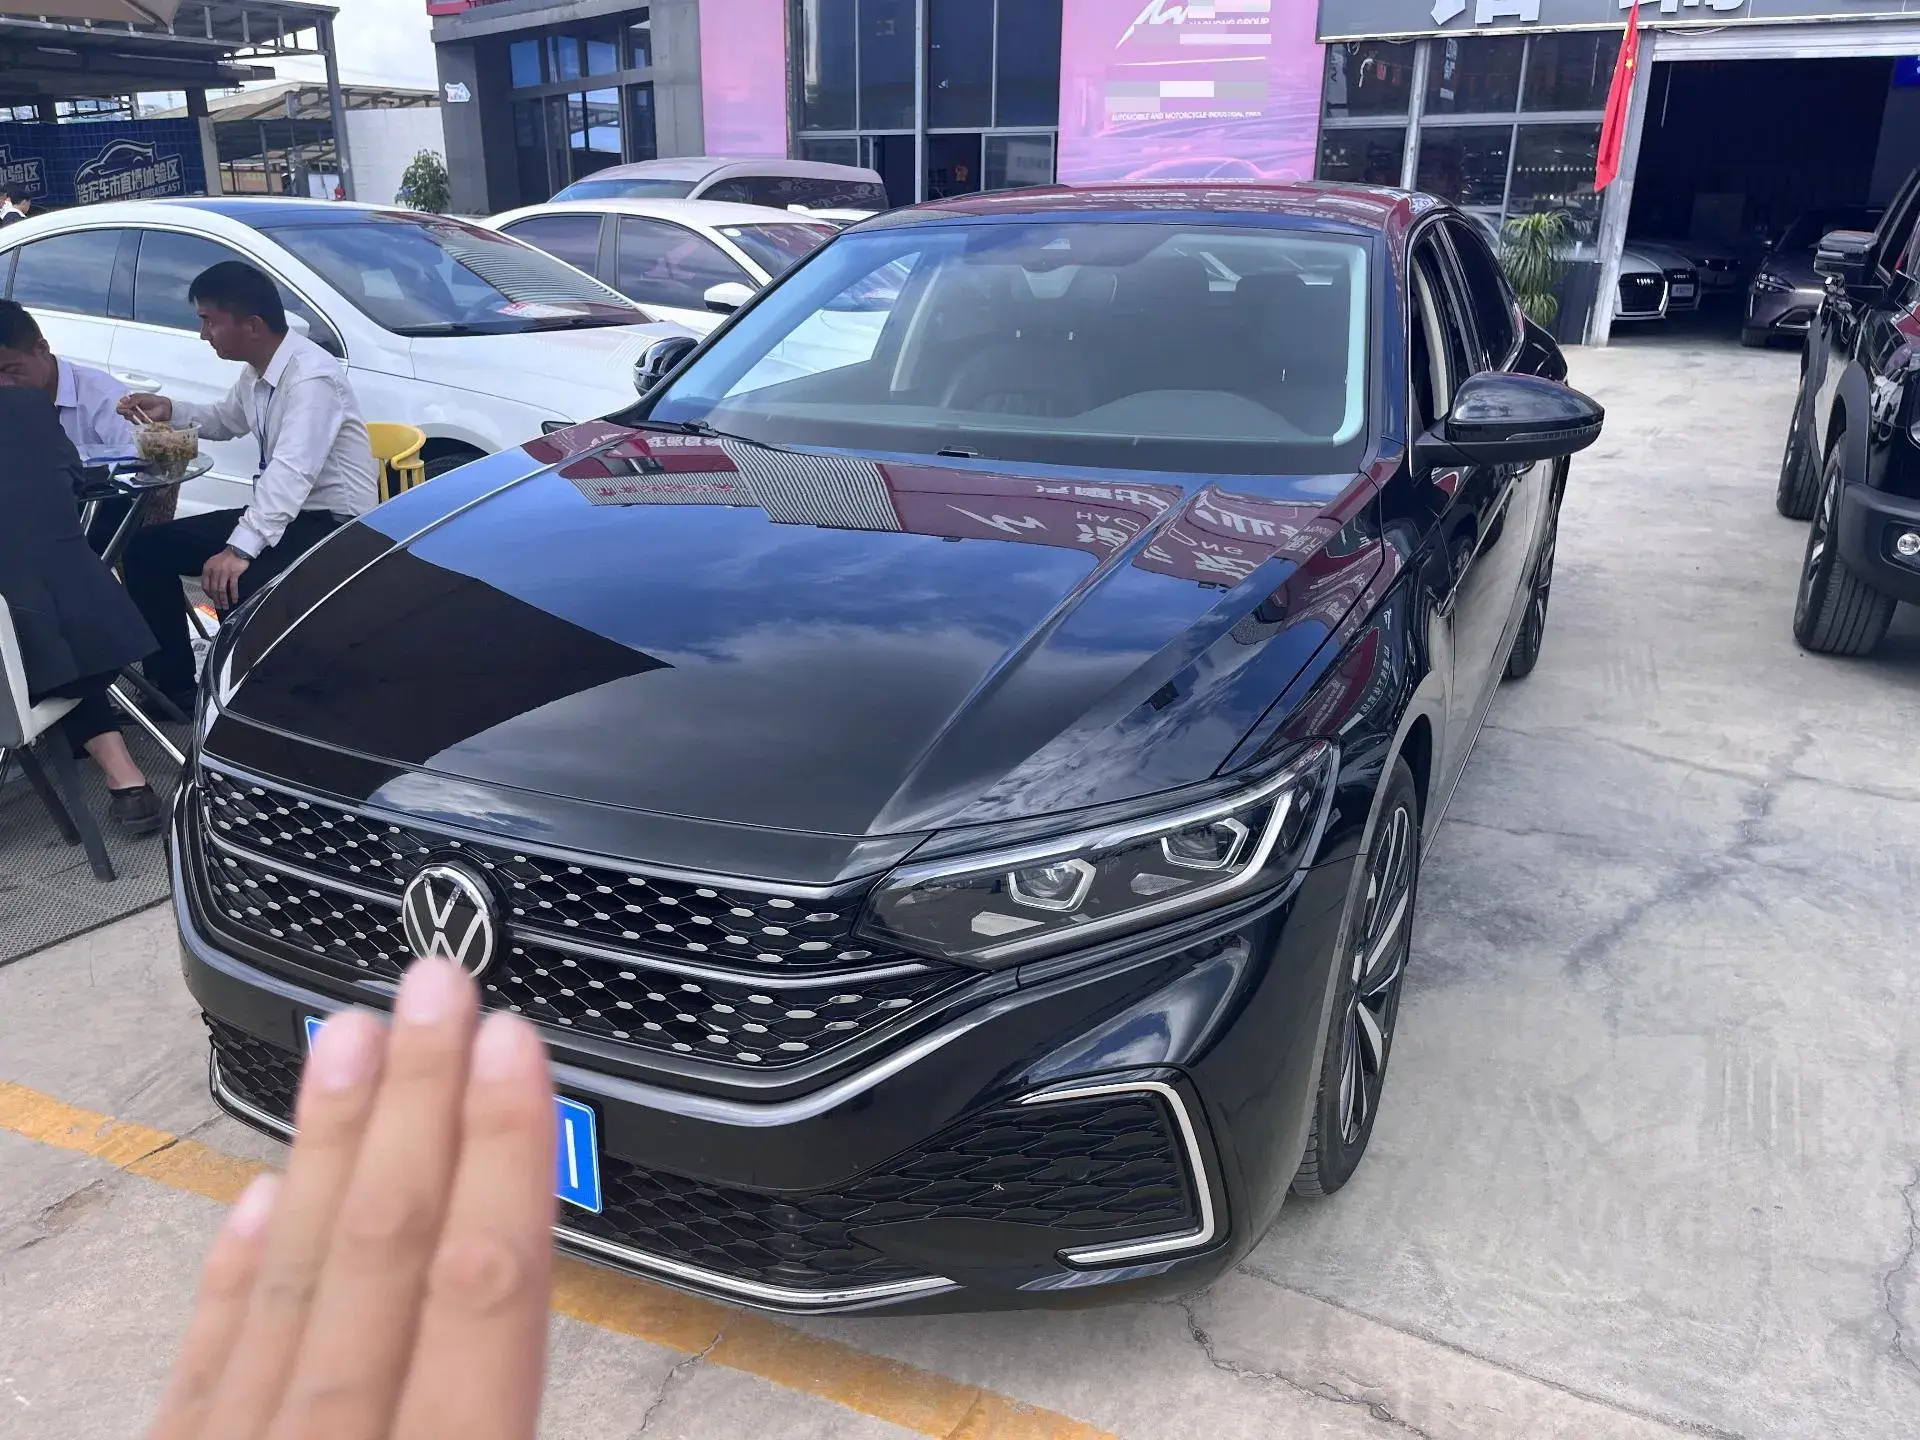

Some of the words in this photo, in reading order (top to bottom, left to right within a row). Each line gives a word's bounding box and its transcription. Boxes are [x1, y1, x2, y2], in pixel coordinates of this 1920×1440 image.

[1112, 112, 1149, 121] AUTOMOBILE
[1150, 112, 1164, 120] AND
[1165, 111, 1207, 120] MOTORCYCLE
[77, 159, 180, 204] 浩宏车市直播体验区
